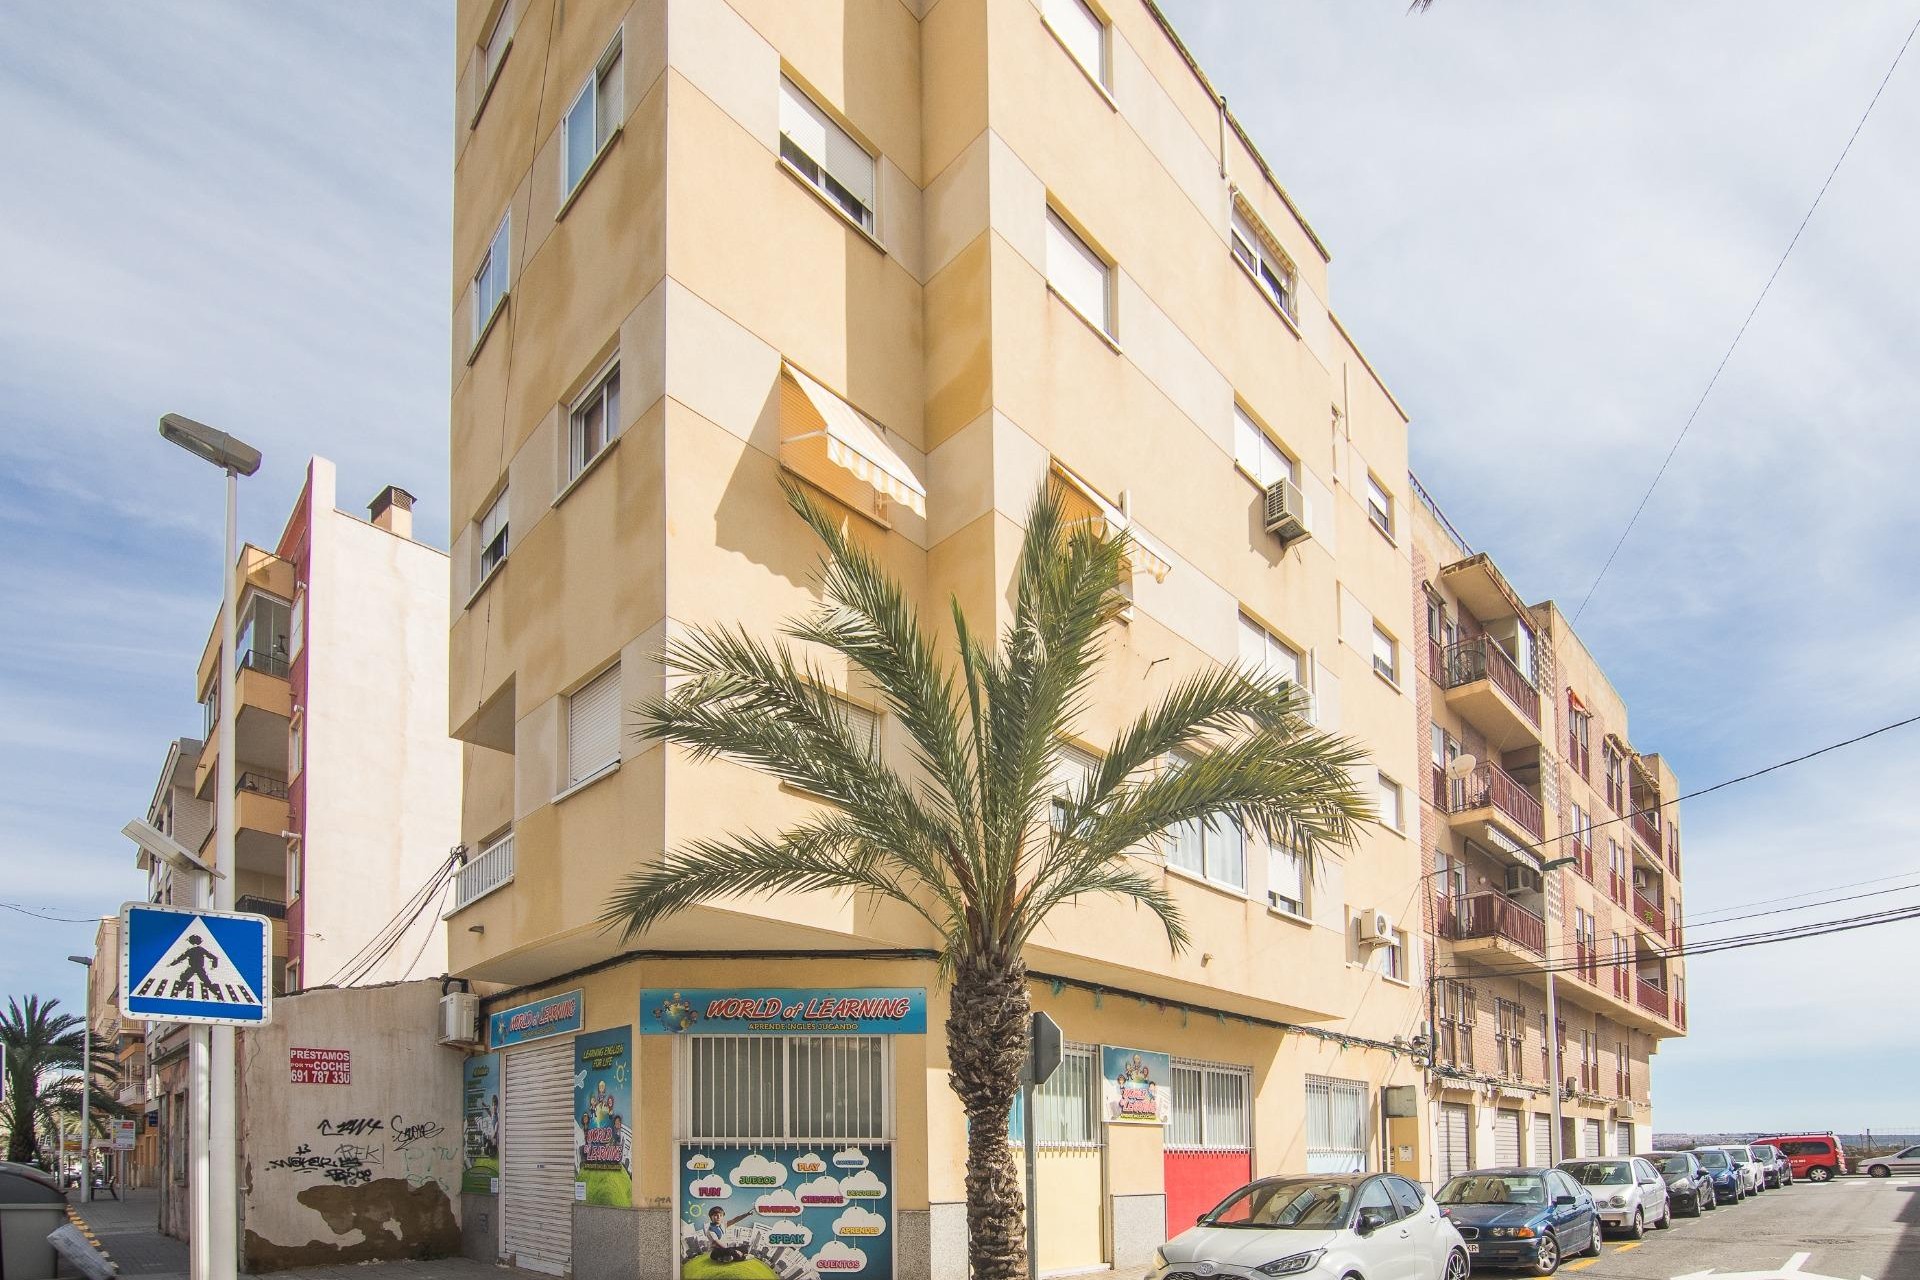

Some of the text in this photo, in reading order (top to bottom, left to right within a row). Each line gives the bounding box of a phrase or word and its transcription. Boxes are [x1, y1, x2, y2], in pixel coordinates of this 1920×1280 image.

[706, 997, 910, 1019] WORLD of LEARNING
[290, 1049, 350, 1061] PRÉSTAMOS
[314, 1061, 350, 1071] COCHE
[291, 1069, 308, 1083] 691
[311, 1070, 330, 1083] 787
[587, 1127, 613, 1142] WORLD
[586, 1145, 623, 1161] LEARNING
[797, 1163, 820, 1171] PLAY
[739, 1176, 777, 1185] JUEGOS
[699, 1187, 722, 1197] FUN
[800, 1195, 844, 1204] CREATIVE
[840, 1226, 880, 1235] APRENDES
[769, 1233, 805, 1245] SPEAK
[816, 1259, 861, 1269] CUENTOS
